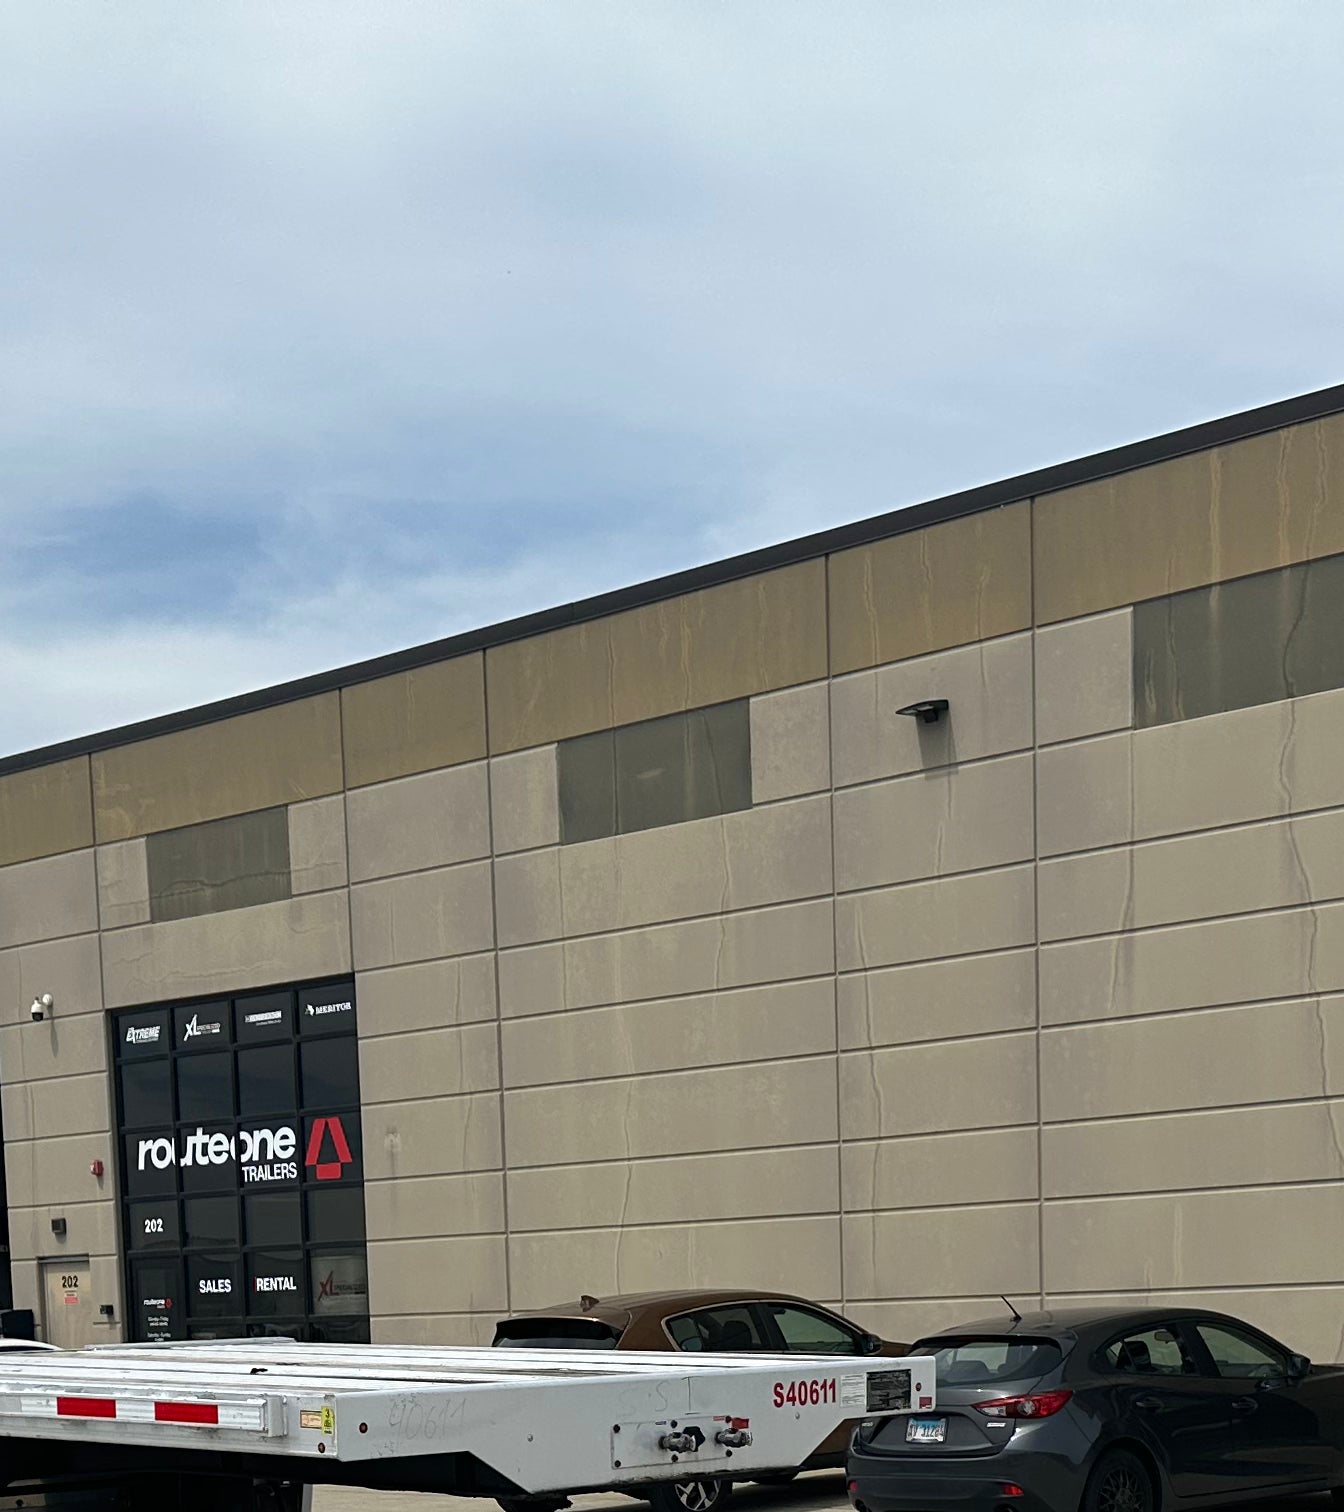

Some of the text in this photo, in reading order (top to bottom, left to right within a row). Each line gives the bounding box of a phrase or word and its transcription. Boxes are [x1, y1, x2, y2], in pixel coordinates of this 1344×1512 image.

[183, 1013, 202, 1042] XL
[137, 1125, 297, 1171] routeone
[241, 1161, 298, 1183] TRAILERS
[144, 1218, 164, 1233] 202
[61, 1275, 79, 1289] 202
[199, 1278, 232, 1294] SALES
[255, 1276, 297, 1292] RENTAL
[318, 1270, 340, 1302] XL
[773, 1377, 836, 1408] S40611
